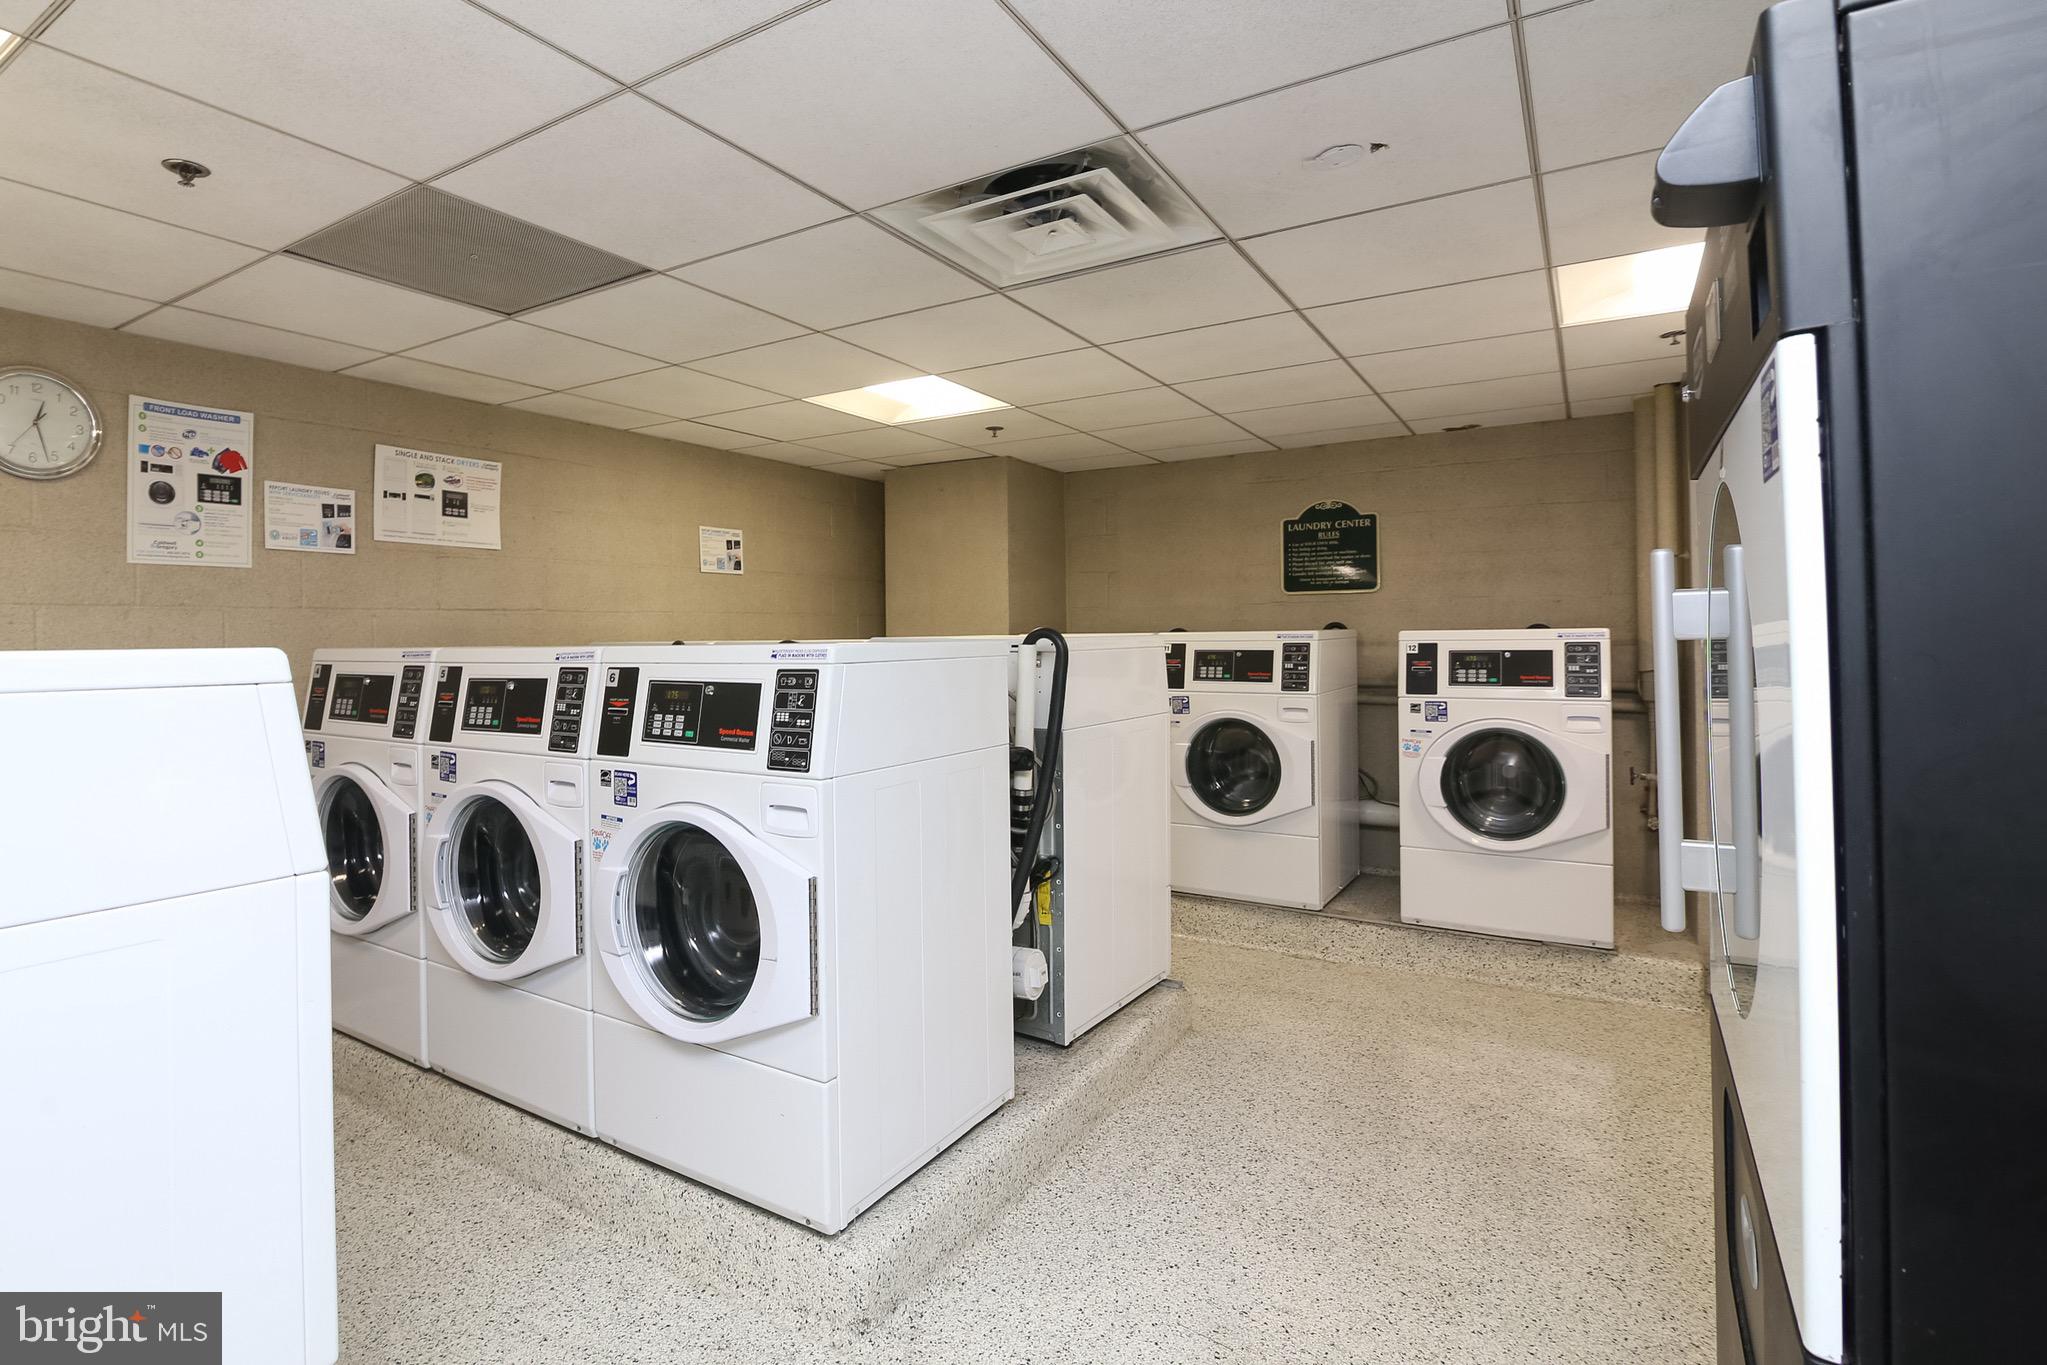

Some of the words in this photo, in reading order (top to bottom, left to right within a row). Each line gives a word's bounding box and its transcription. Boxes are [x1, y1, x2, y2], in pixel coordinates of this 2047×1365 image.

[9, 384, 19, 395] 11
[31, 382, 42, 393] 12
[56, 392, 62, 403] 1
[69, 406, 80, 417] 2
[148, 404, 175, 414] FRONT
[177, 408, 199, 418] LOAD
[200, 411, 235, 423] WASHER
[75, 424, 84, 435] 3
[8, 443, 16, 454] 7
[67, 441, 75, 451] 4
[28, 452, 37, 464] 6
[50, 450, 60, 461] 5
[395, 449, 418, 460] SINGLE
[419, 454, 434, 462] AND
[434, 456, 455, 465] STACK
[456, 459, 480, 469] DRYERS
[1288, 522, 1333, 532] LAUNDRY
[1335, 518, 1371, 529] CENTER
[1318, 531, 1340, 539] RULES
[440, 669, 446, 679] 5
[609, 672, 616, 683] 6
